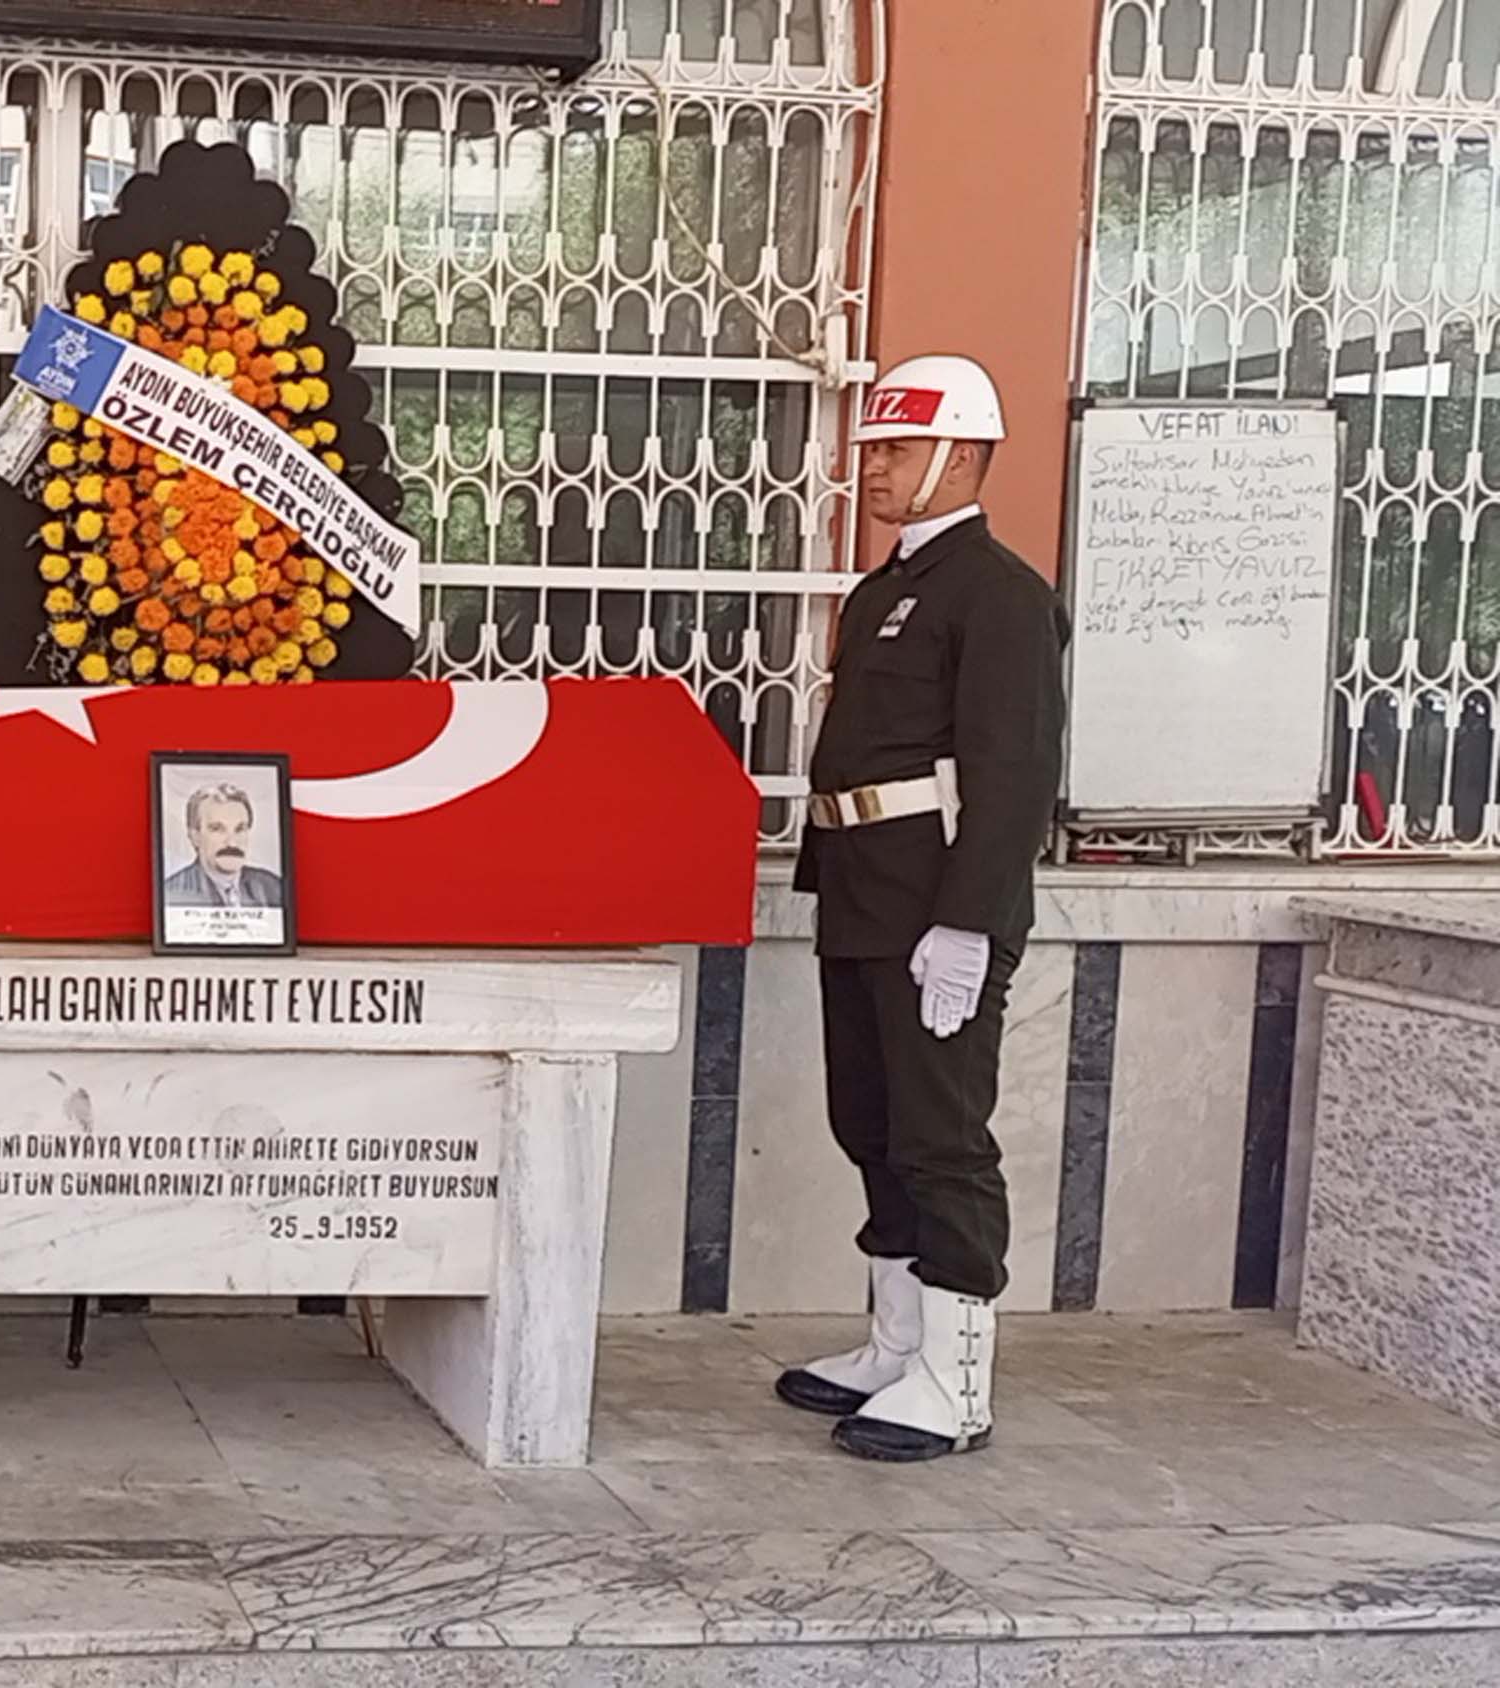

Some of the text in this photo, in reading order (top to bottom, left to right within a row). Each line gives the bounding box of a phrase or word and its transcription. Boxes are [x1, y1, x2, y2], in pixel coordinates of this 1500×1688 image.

[102, 390, 225, 471] ÖZLEM
[1137, 411, 1227, 440] VEFAT
[119, 361, 408, 573] AYDIN BÜYÜKŞEHİR BELEDİYE BAŞKANI
[1090, 553, 1327, 601] FİKRET YAVUZ
[59, 976, 136, 1023] GANİ
[144, 977, 279, 1023] RAHMET
[287, 978, 426, 1025] EYLESİN
[27, 1134, 121, 1160] DÜNYAYA
[346, 1137, 479, 1163] GİDİYORSUN
[60, 1172, 223, 1198] GÜNAHLARINIZI
[388, 1173, 499, 1199] BUYURSUN
